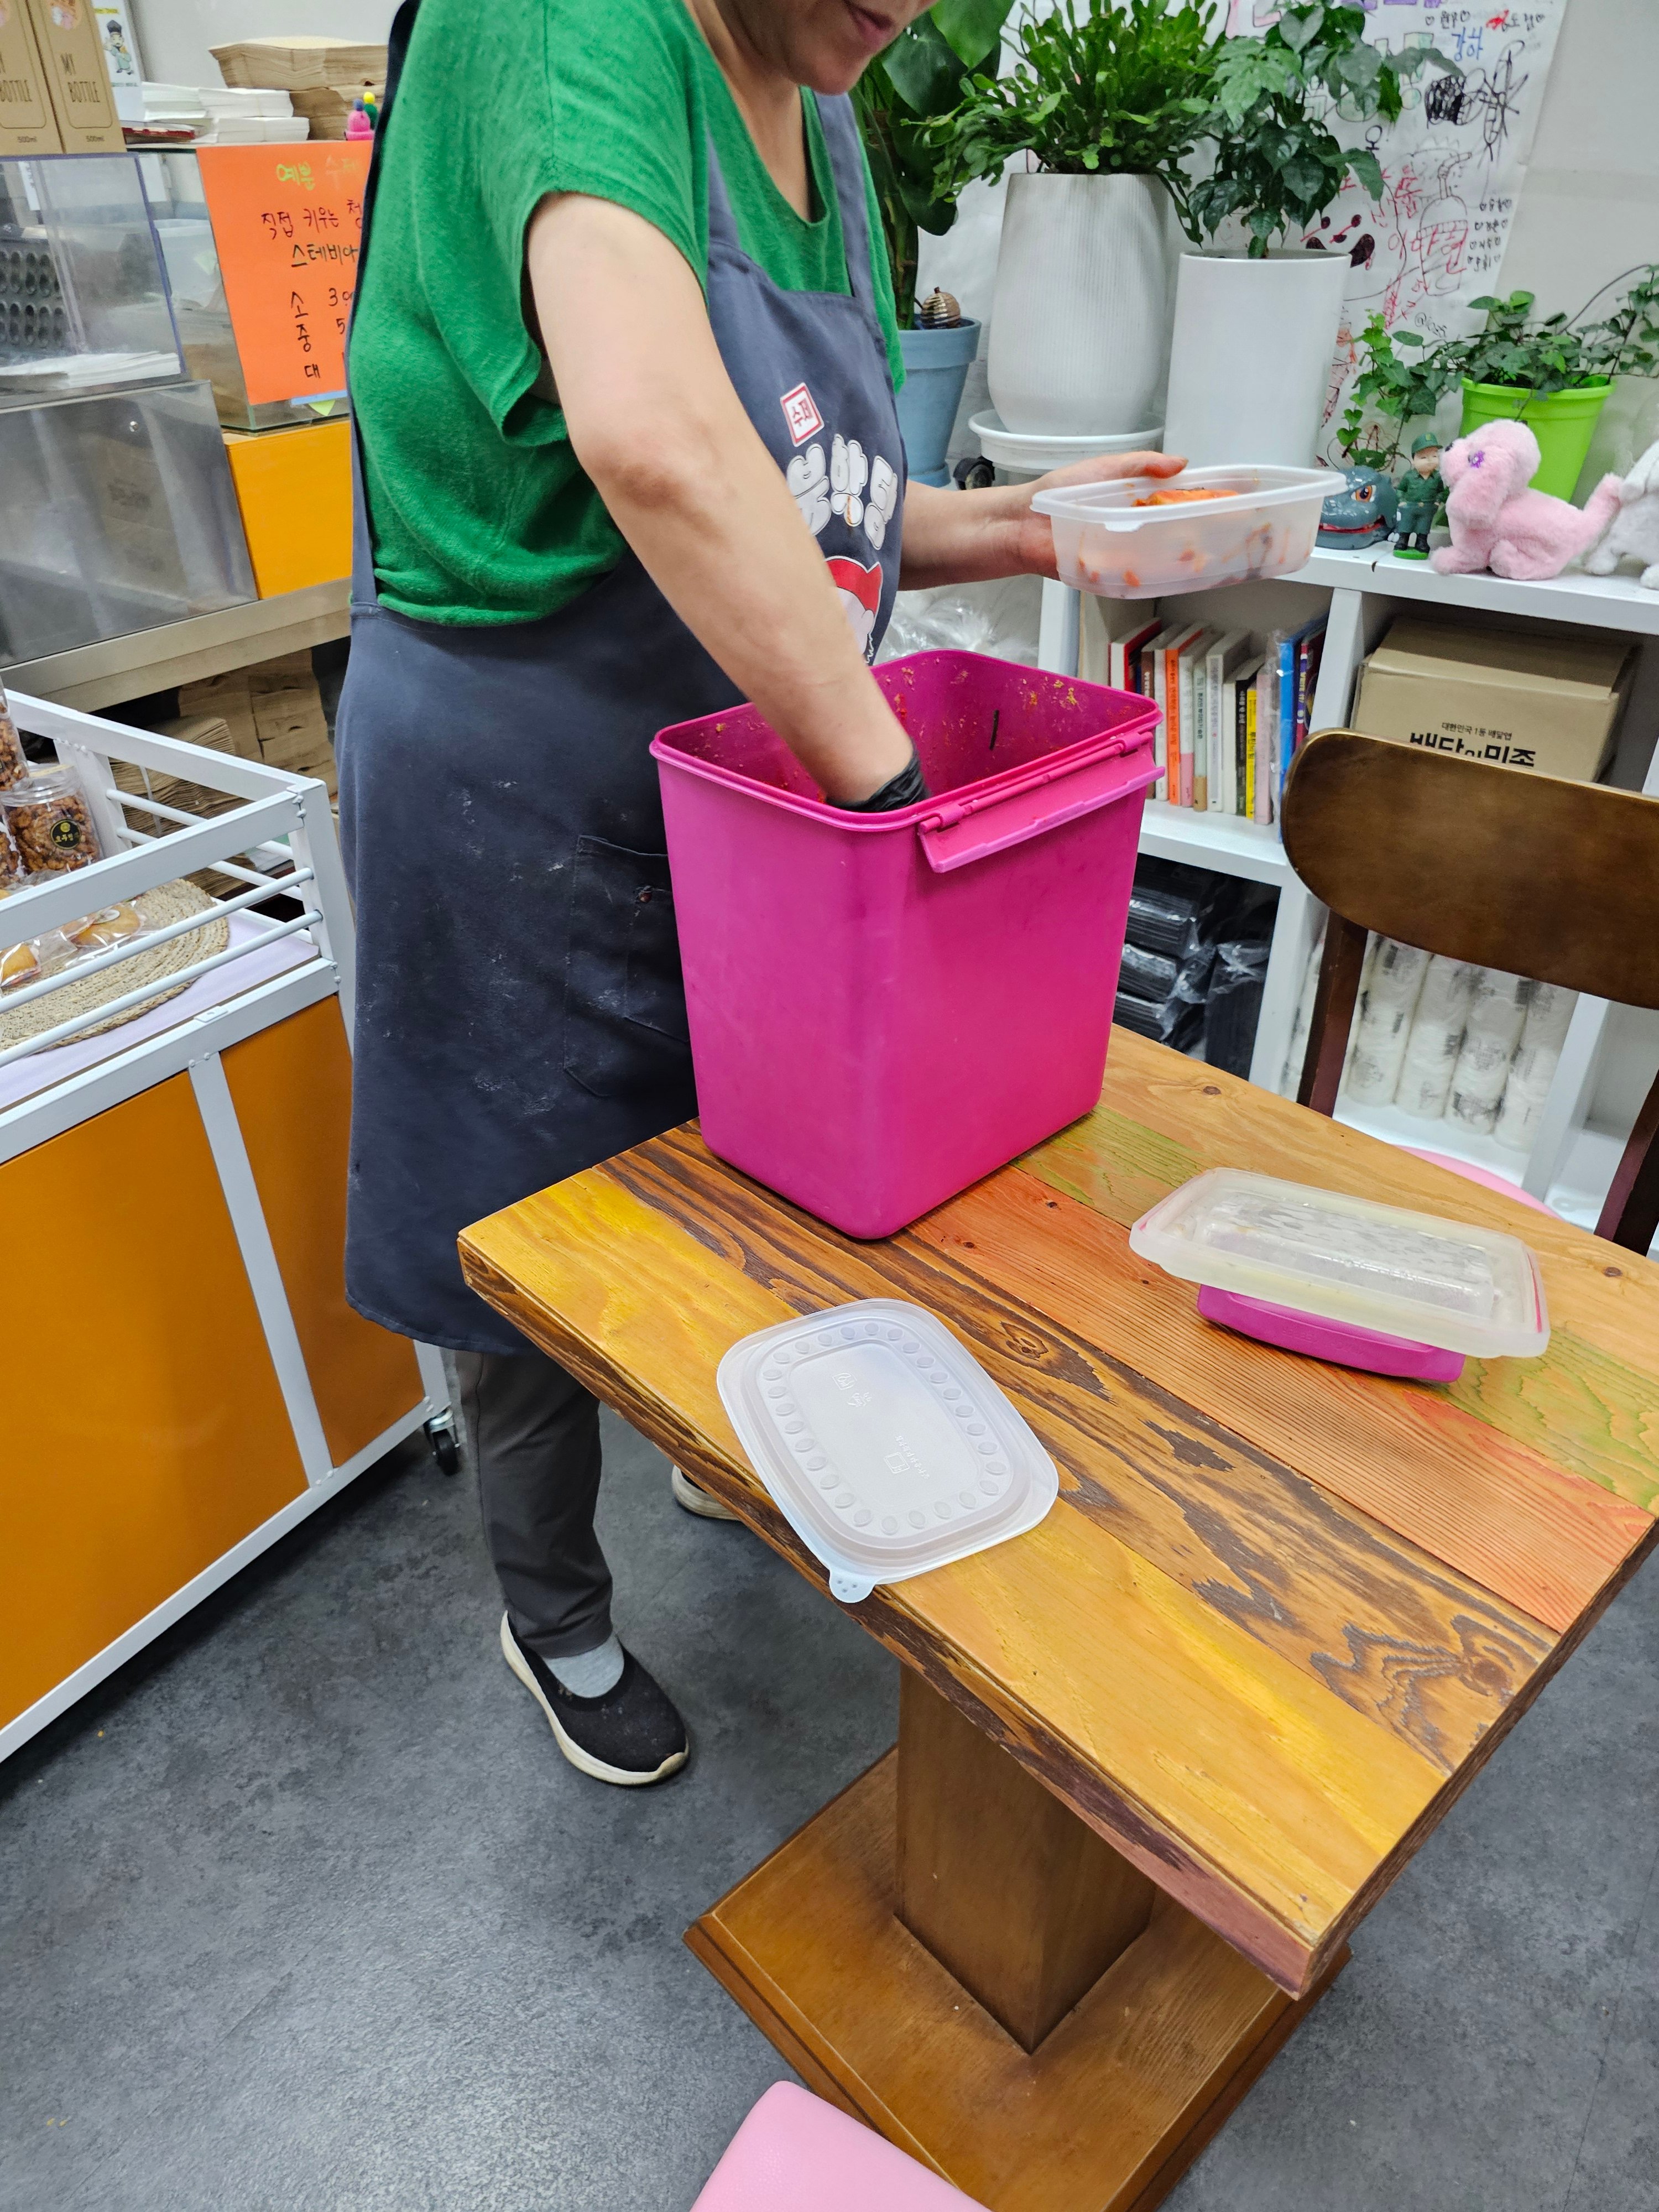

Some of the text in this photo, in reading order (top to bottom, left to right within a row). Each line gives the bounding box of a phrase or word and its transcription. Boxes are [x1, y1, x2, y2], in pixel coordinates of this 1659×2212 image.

[61, 53, 76, 76] MY
[67, 81, 101, 103] BOTTLE
[260, 211, 294, 240] 직접
[303, 206, 340, 233] 키우는
[291, 244, 359, 268] 스테비아
[290, 291, 309, 319] 소
[296, 324, 311, 352] 중
[304, 363, 321, 379] 대
[1441, 722, 1472, 735] 대한민국
[1488, 729, 1512, 741] 배달앱
